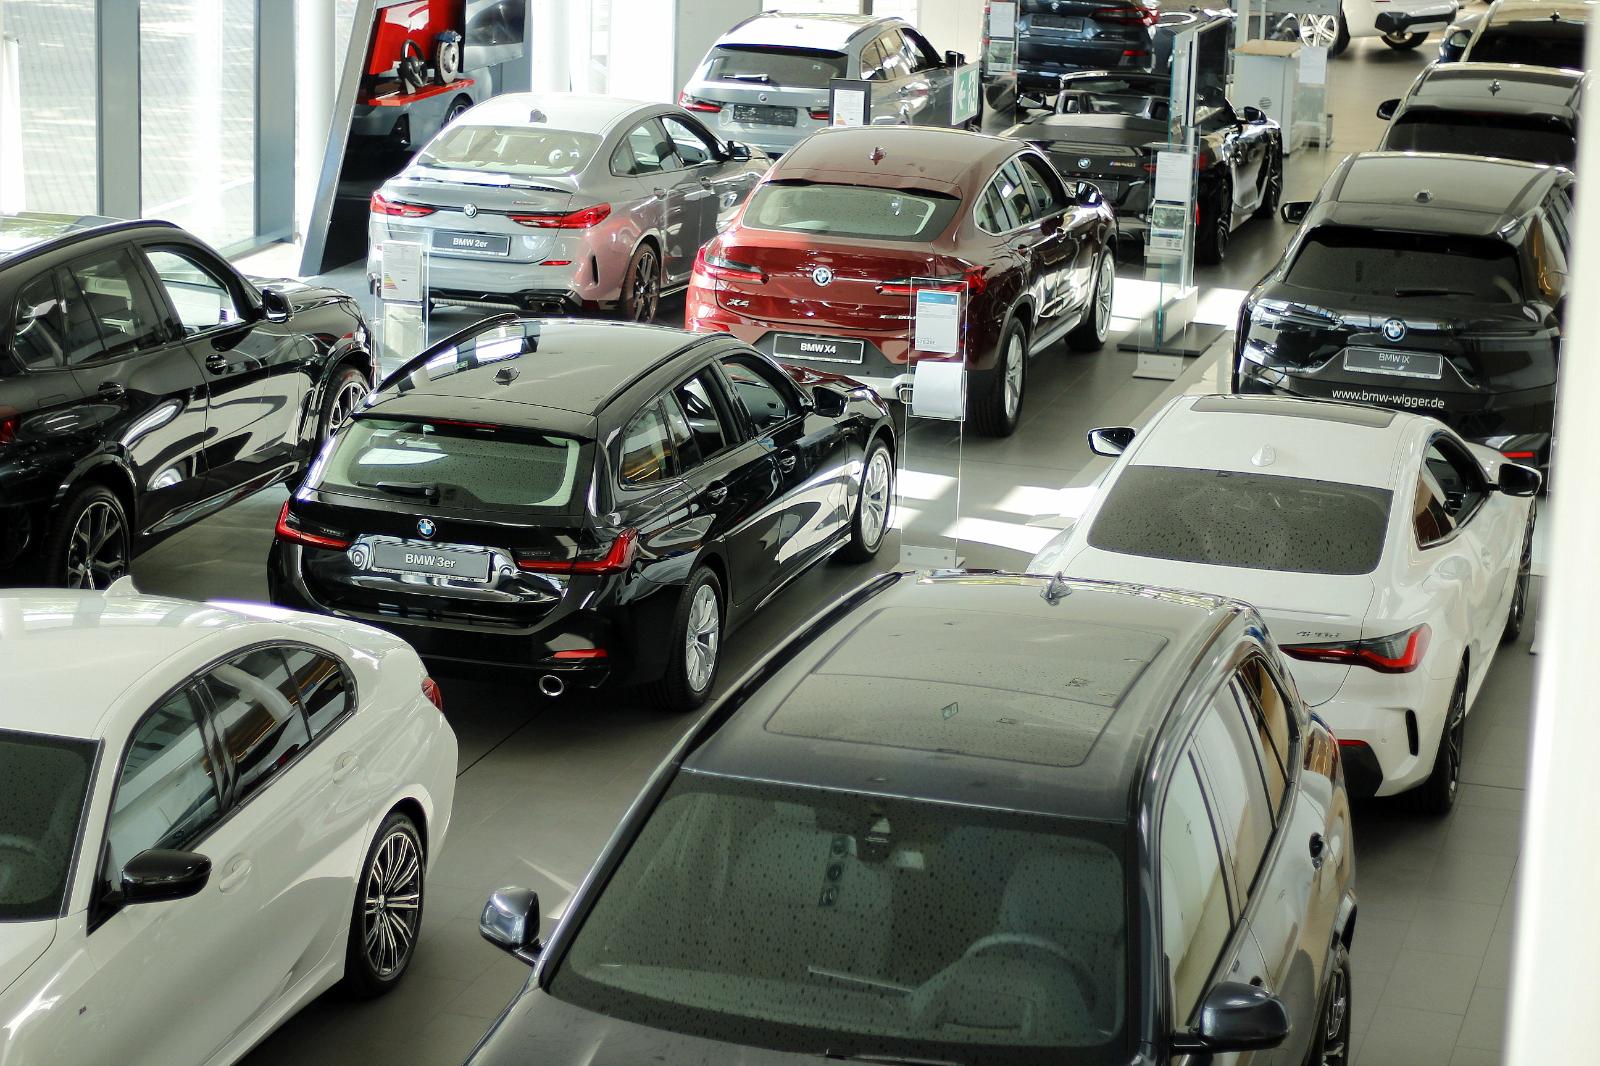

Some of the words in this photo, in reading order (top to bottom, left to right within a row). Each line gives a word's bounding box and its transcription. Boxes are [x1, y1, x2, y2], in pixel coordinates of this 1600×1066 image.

[453, 237, 474, 247] BMW
[475, 239, 488, 248] 2er
[726, 298, 750, 308] X4
[800, 342, 823, 353] BMW
[823, 344, 837, 354] X4
[1378, 352, 1400, 363] BMW
[1332, 390, 1445, 409] www.bmw-wigger.de
[405, 553, 437, 566] BMW
[437, 557, 456, 568] 3er
